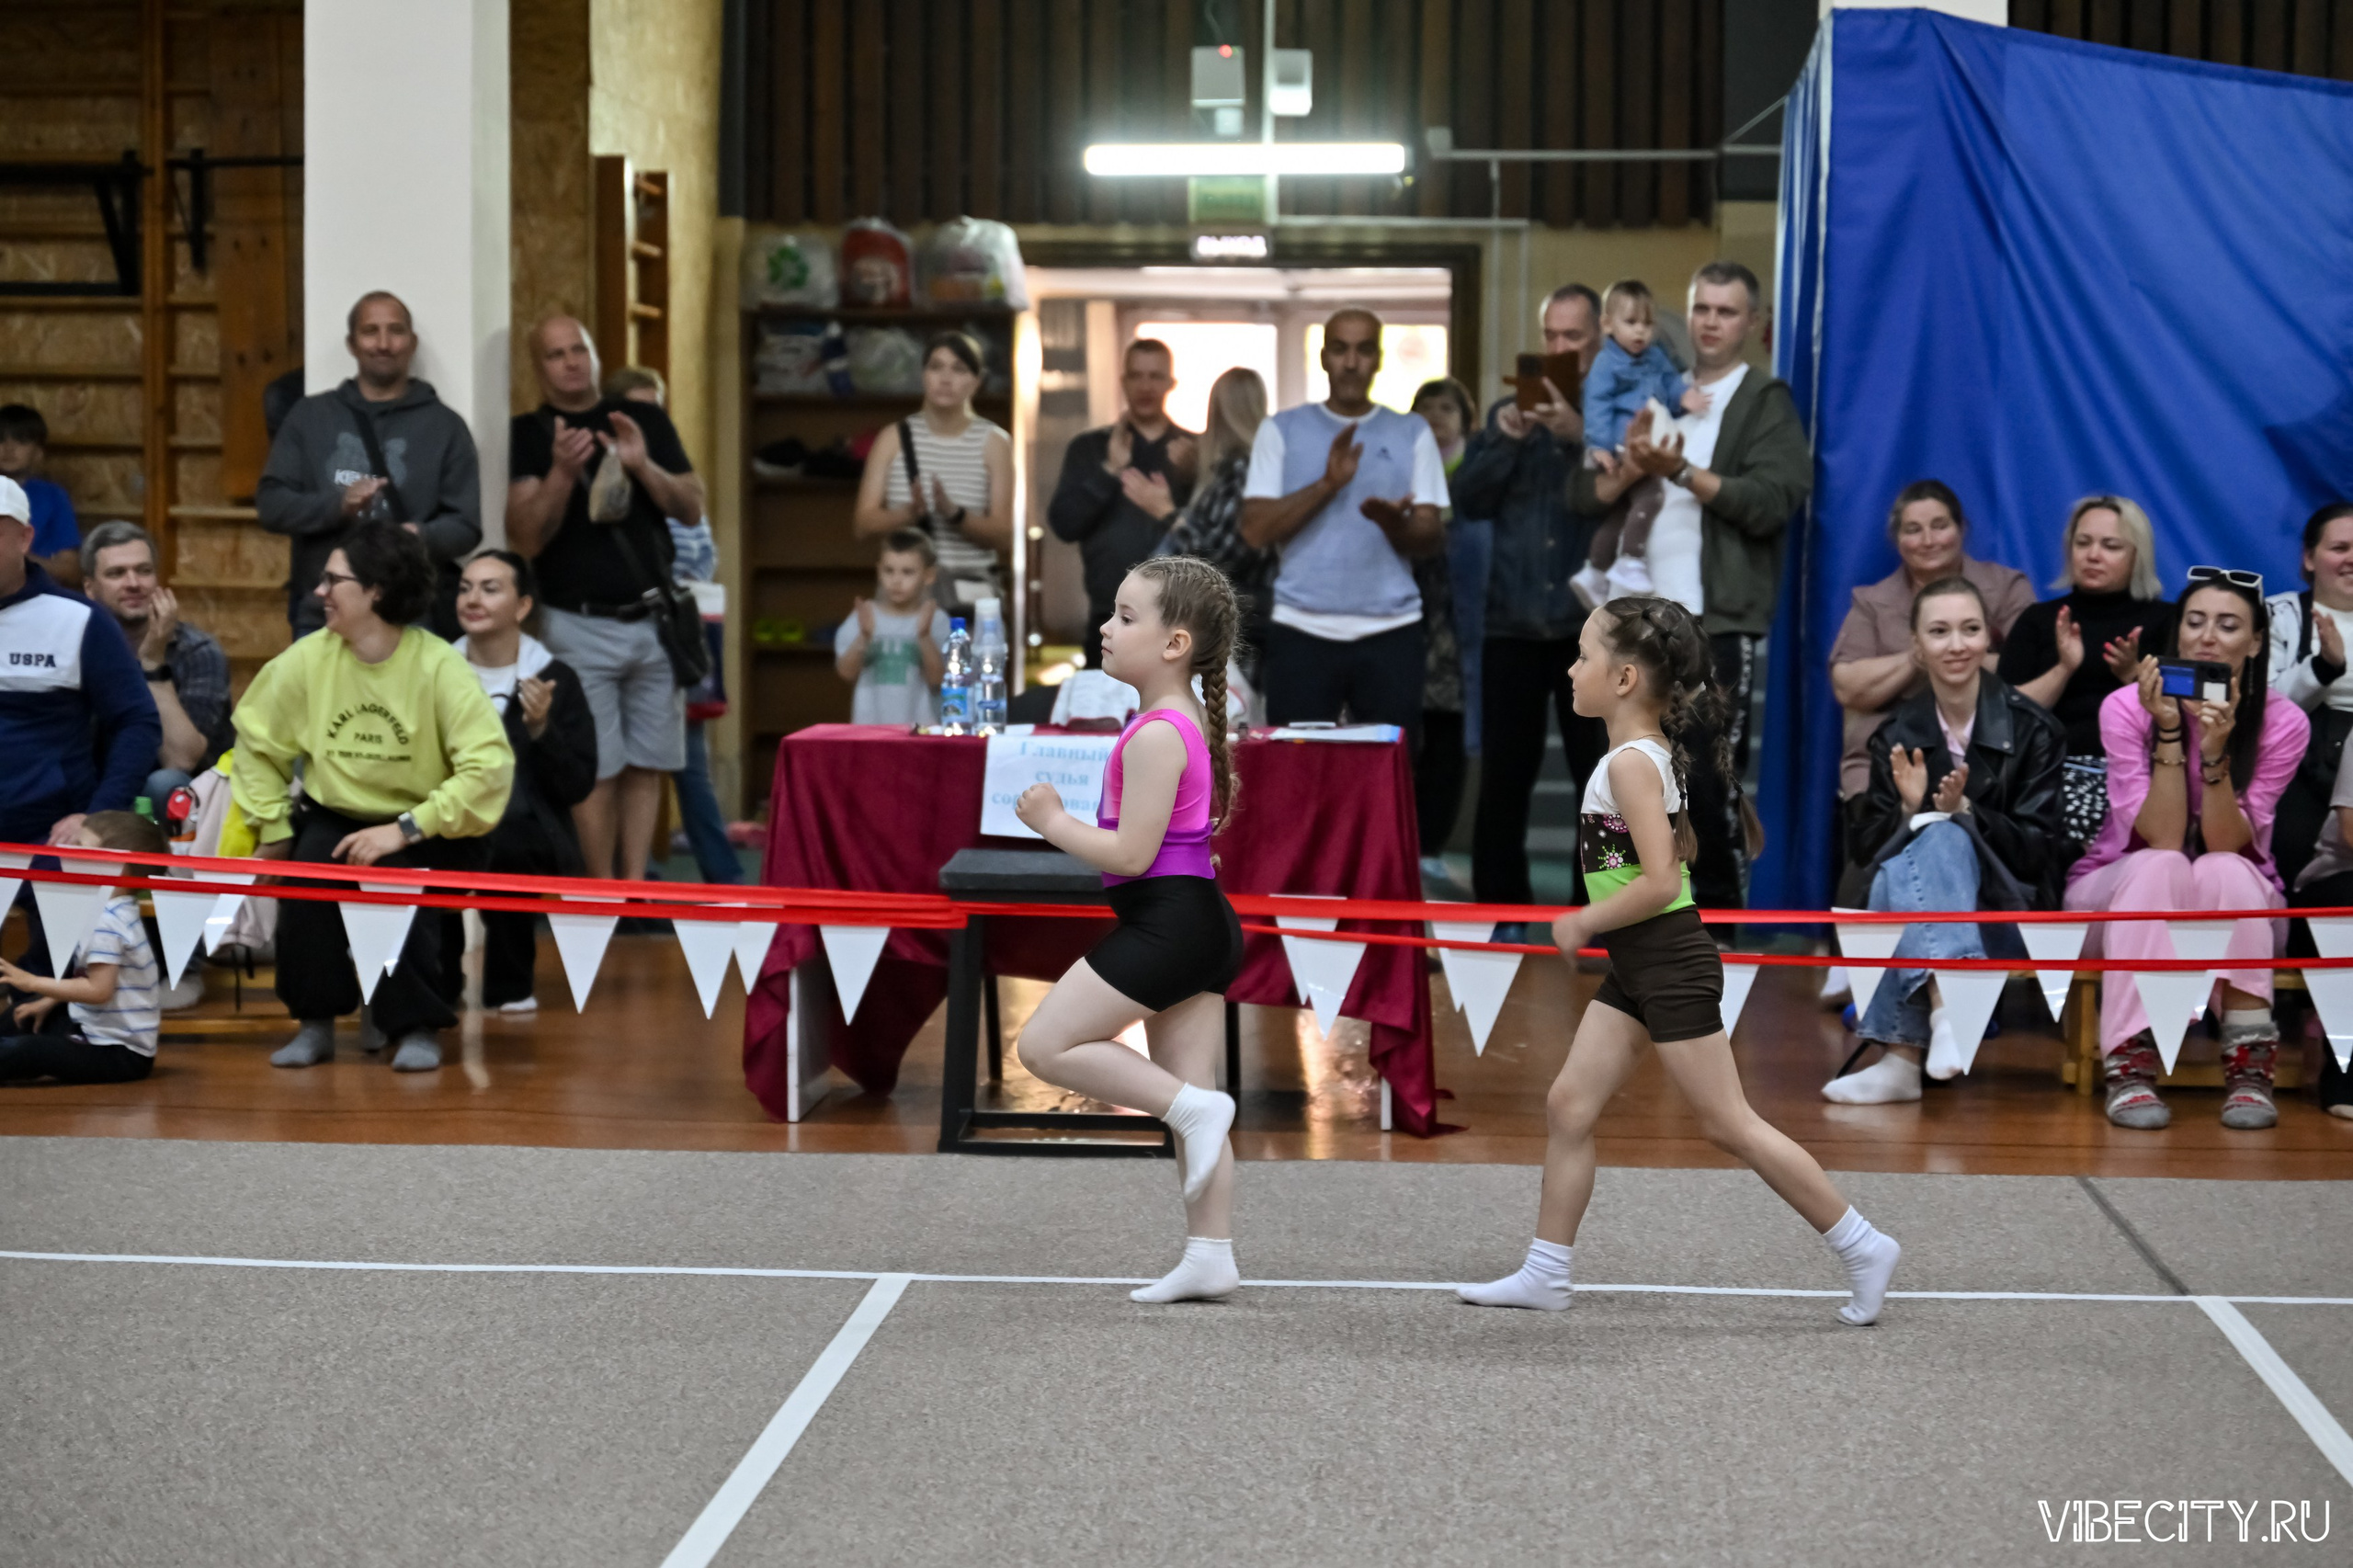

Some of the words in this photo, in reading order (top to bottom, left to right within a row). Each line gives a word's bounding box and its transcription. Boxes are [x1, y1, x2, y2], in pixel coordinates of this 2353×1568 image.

[9, 653, 57, 668] USPA
[326, 709, 354, 739] KARL
[354, 702, 410, 745] LAGERFELD
[354, 732, 383, 744] PARIS
[1034, 769, 1089, 787] судья
